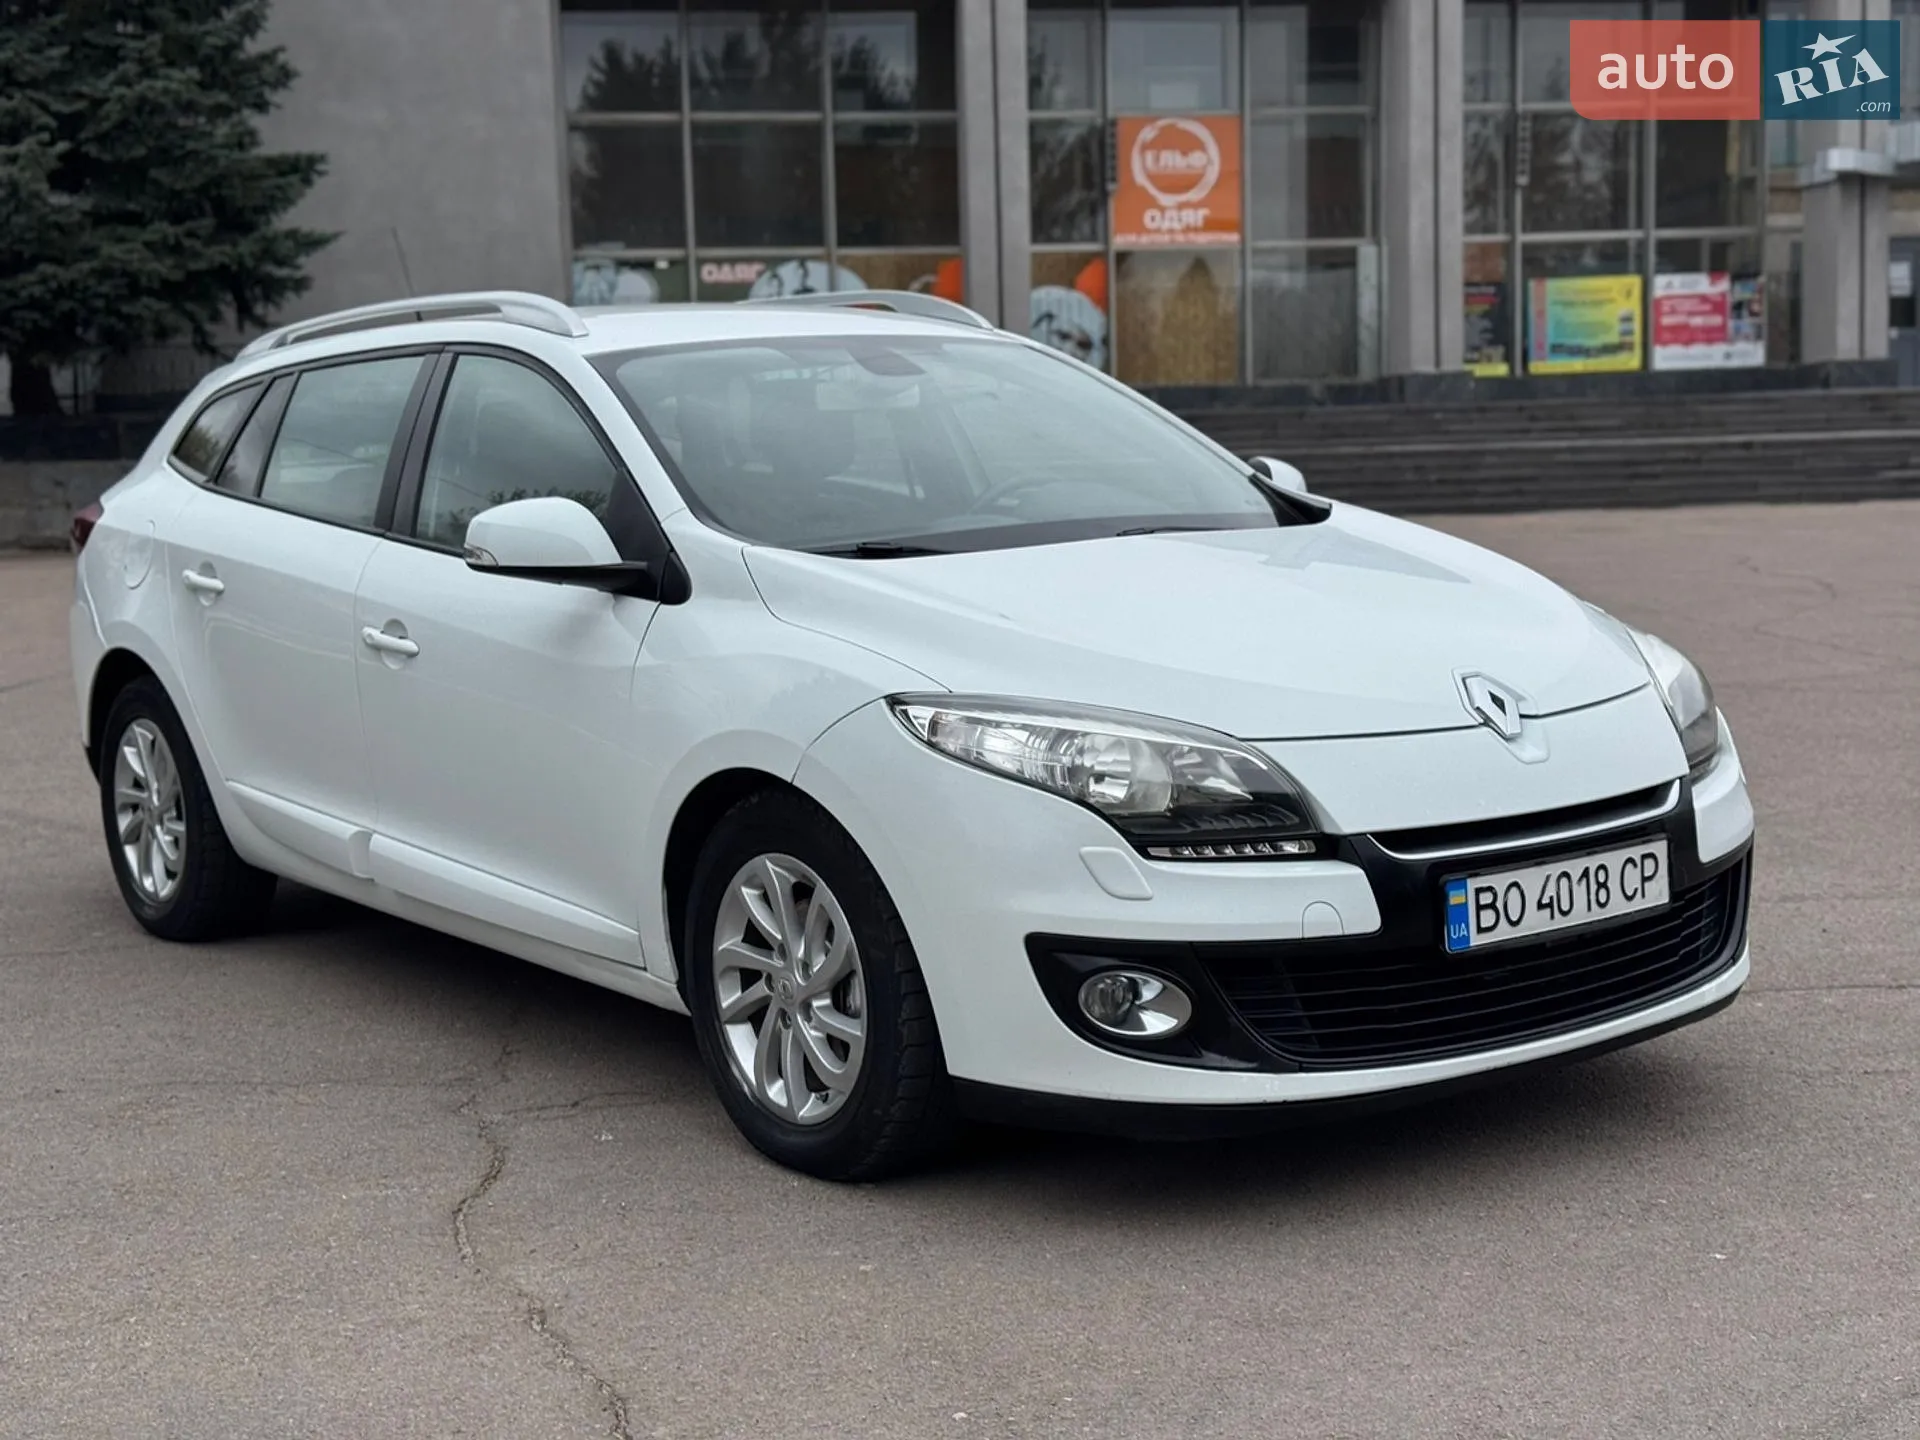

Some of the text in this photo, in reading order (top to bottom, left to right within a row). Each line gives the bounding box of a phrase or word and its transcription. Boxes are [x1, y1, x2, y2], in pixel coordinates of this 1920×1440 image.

[1473, 851, 1660, 935] BO 4018 CP
[1450, 923, 1469, 939] UA
